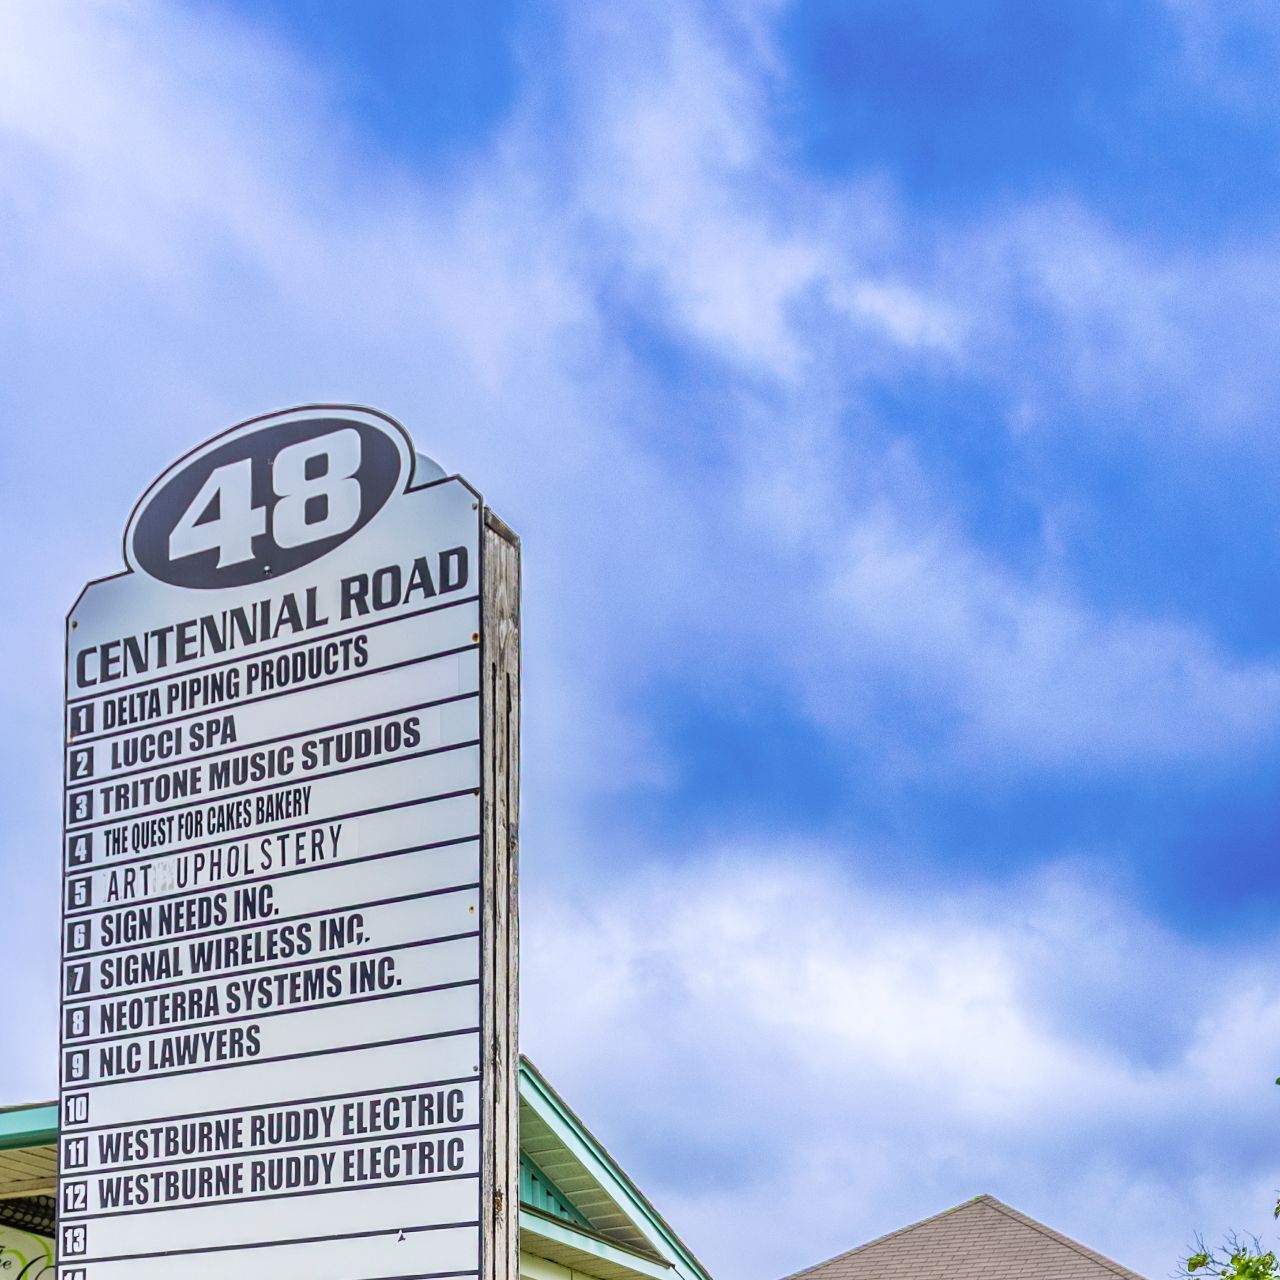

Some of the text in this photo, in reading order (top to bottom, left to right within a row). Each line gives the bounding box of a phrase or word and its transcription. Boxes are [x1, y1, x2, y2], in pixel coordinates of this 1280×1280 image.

[169, 428, 361, 569] 48
[76, 546, 469, 689] CENTENNIAL ROAD
[78, 635, 368, 731] 1 DELTA PIPING PRODUCTS
[75, 717, 421, 819] 3 TRITONE MUSIC STUDIOS
[76, 715, 236, 776] 2 LUCCI SPA
[74, 786, 311, 862] 4 THE QUEST FOR CAKES BAKERY
[74, 824, 342, 905] 5 ART UPHOLSTERY
[72, 913, 370, 990] 7 SIGNAL WIRELESS INC.
[73, 884, 279, 948] 6 SIGN NEEDS INC.
[72, 957, 402, 1034] 8 NEOTERRA SYSTEMS INC.
[71, 1025, 260, 1078] 9 NLC LAWYERS
[67, 1098, 86, 1122] 10
[68, 1089, 464, 1165] 11 WESTBURNE RUDDY ELECTRIC
[65, 1138, 464, 1210] 12 WESTBURNE RUDDY ELECTRIC
[65, 1229, 85, 1252] 13
